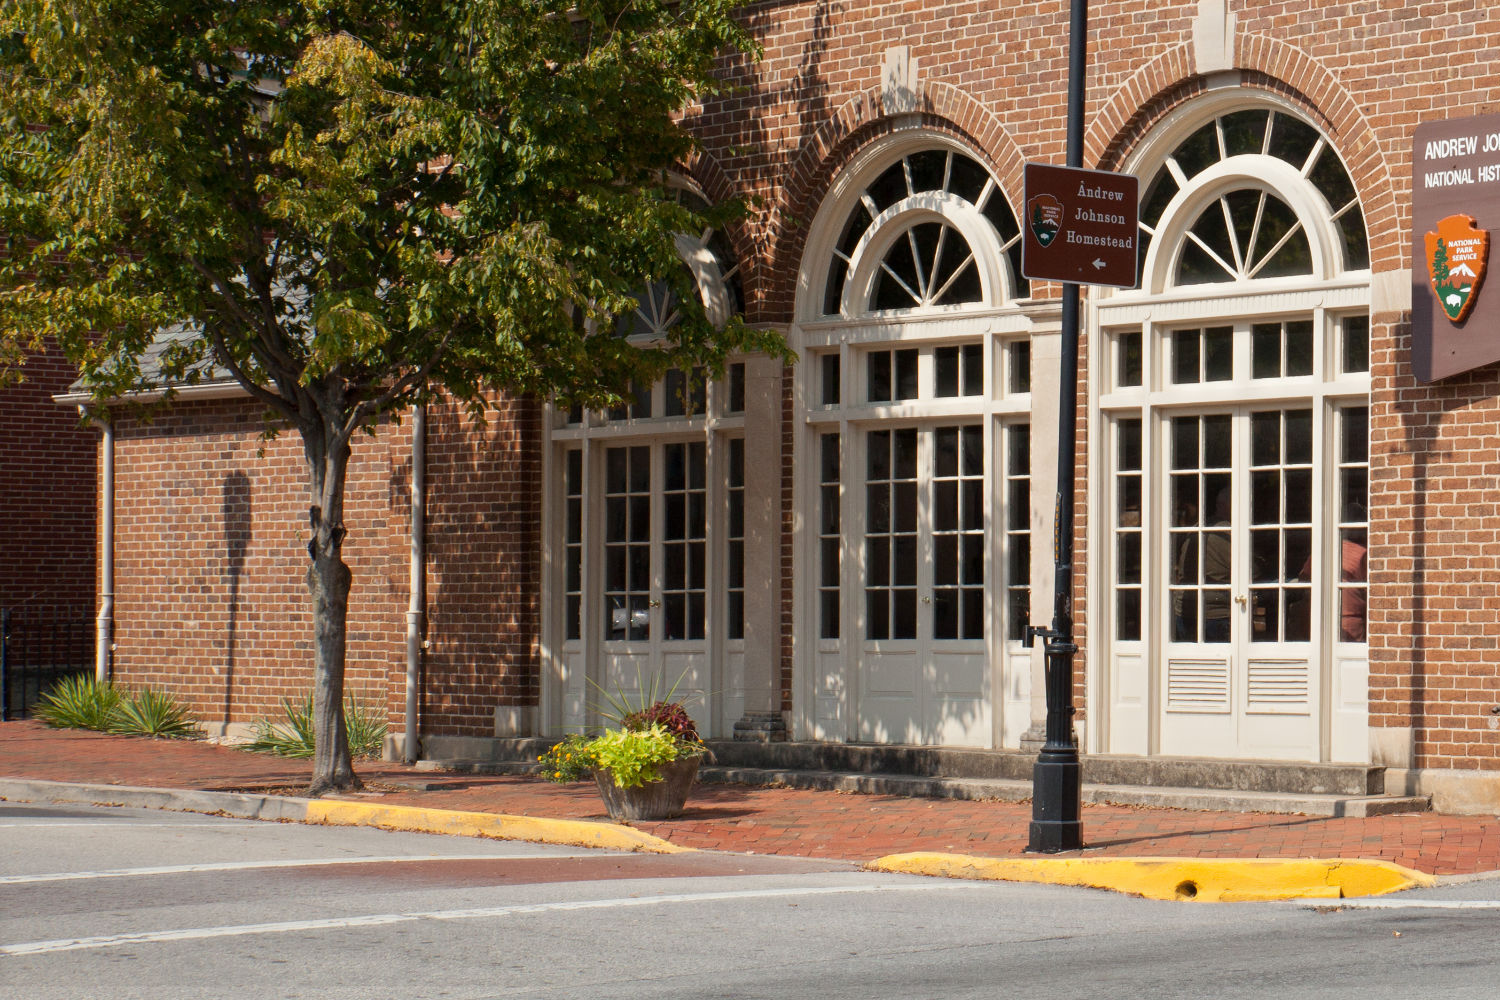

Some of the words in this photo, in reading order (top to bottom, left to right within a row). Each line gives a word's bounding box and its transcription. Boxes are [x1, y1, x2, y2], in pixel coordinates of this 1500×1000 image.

[1424, 135, 1478, 160] ANDREW
[1424, 168, 1475, 188] NATIONAL
[1077, 184, 1124, 201] Andrew
[1075, 207, 1126, 225] Johnson
[1066, 230, 1133, 249] Homestead
[1448, 238, 1481, 248] NATIONAL
[1452, 252, 1477, 262] SERVICE
[1456, 246, 1473, 255] PARK
